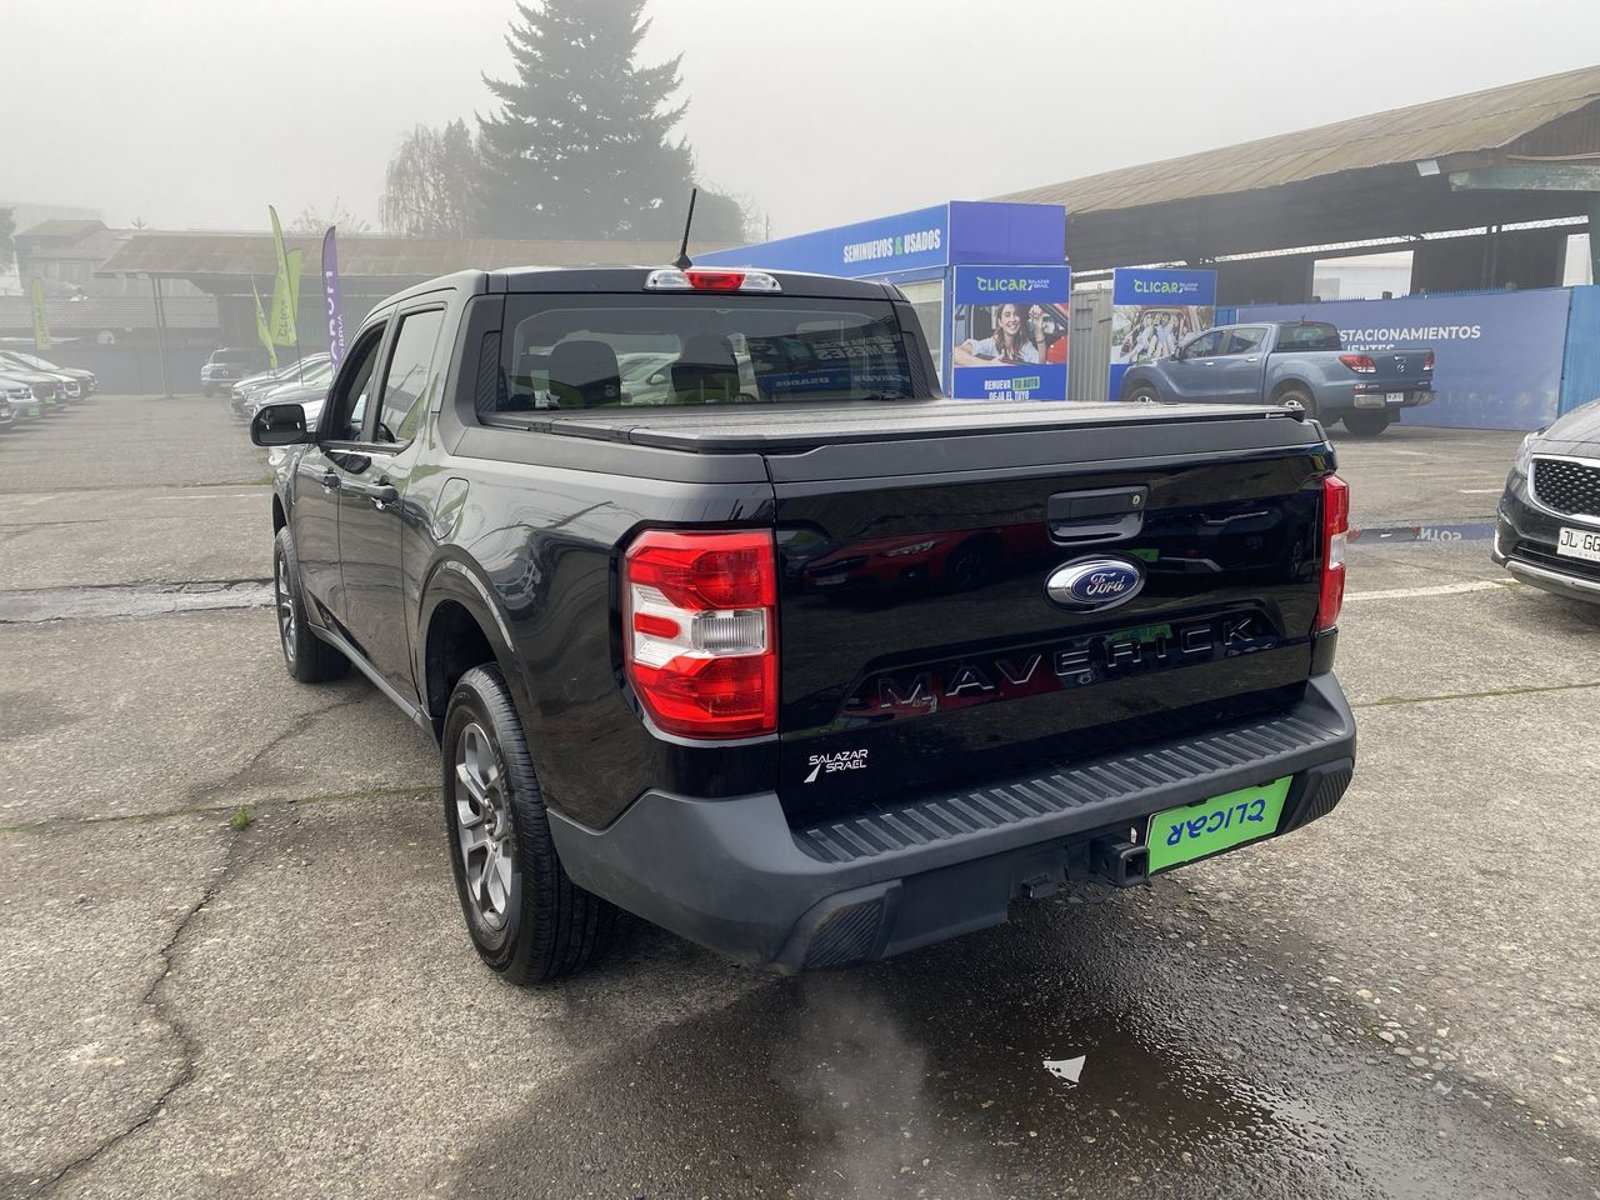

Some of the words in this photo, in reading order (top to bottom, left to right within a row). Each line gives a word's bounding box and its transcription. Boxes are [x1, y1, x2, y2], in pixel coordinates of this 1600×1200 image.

[843, 237, 893, 264] SEMINUEVOS
[895, 236, 902, 256] &
[904, 228, 941, 254] USADOS
[1338, 325, 1481, 342] STACIONAMIENTOS
[1085, 571, 1126, 597] Ford
[877, 614, 1256, 708] MAVERICK
[809, 748, 869, 766] SALAZAR
